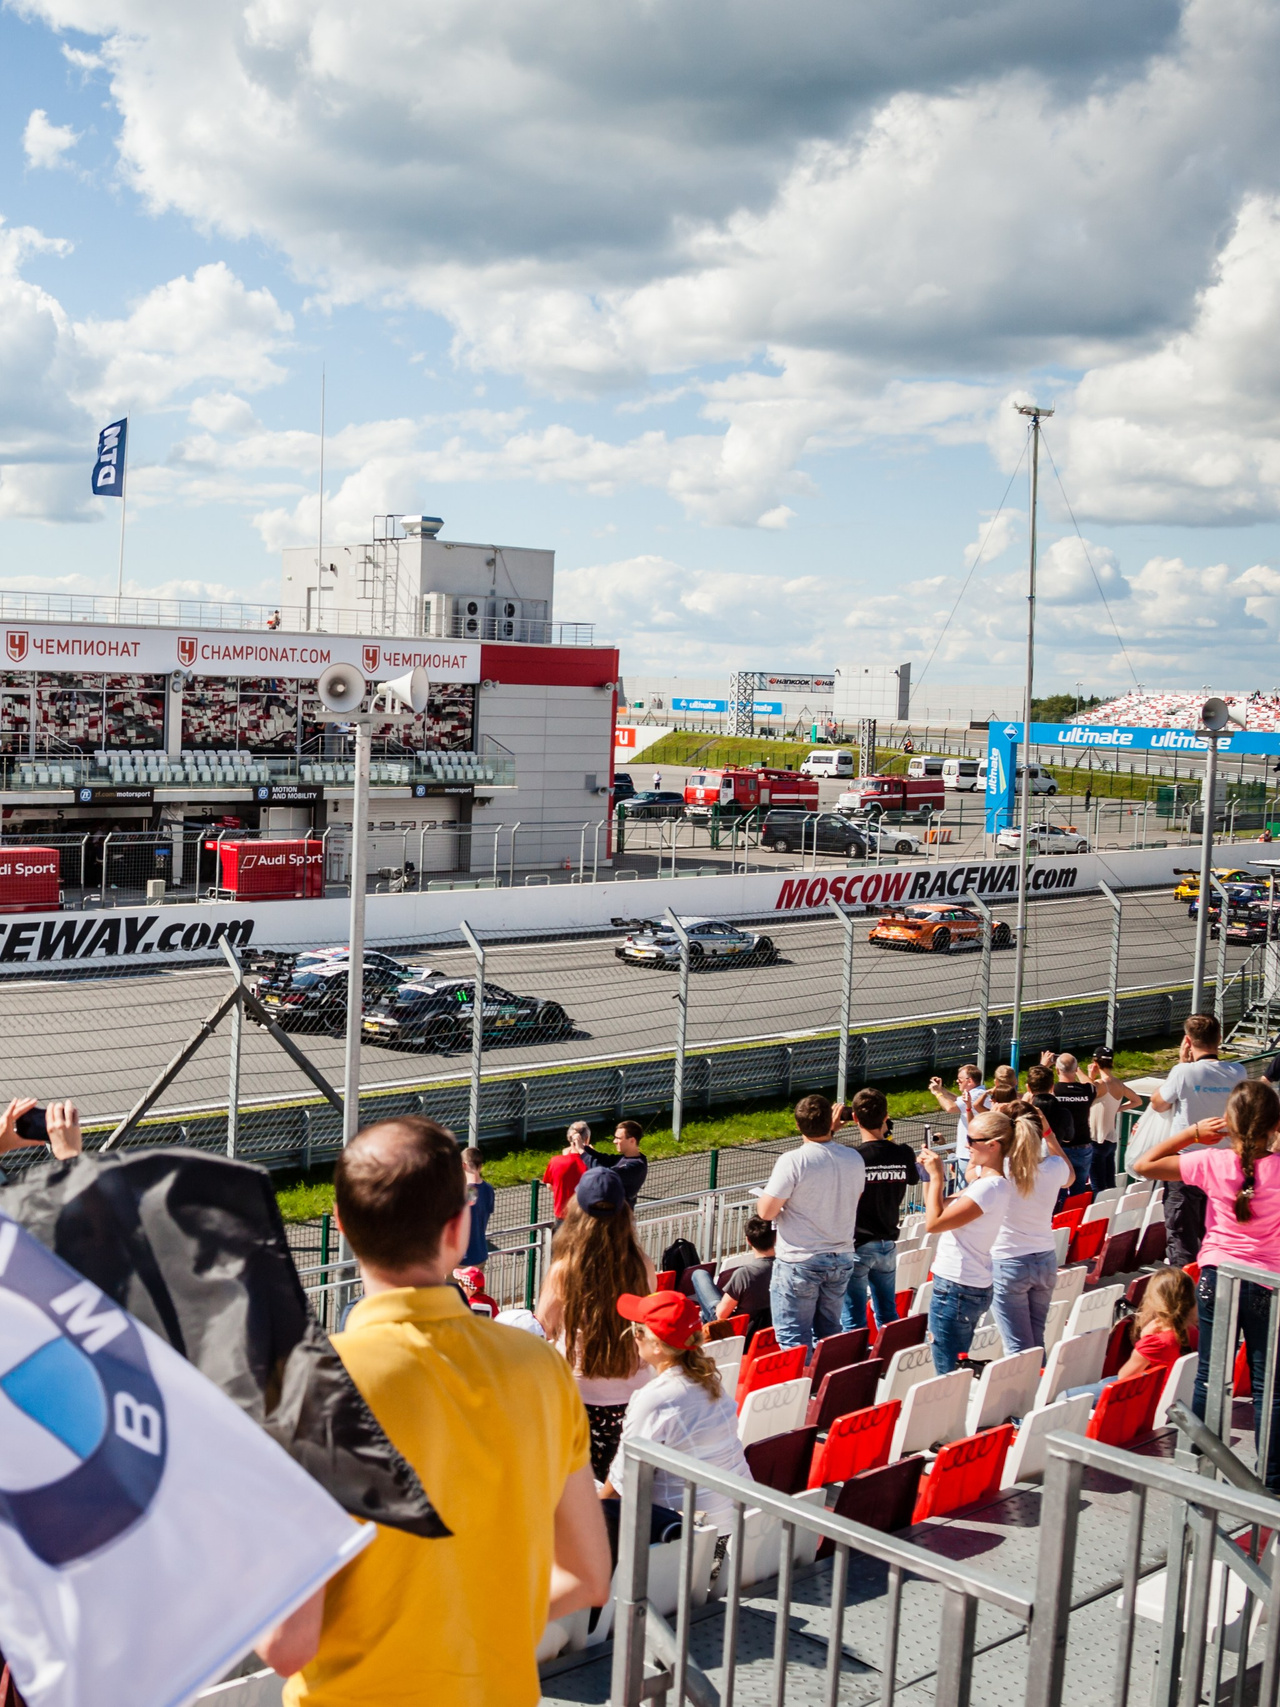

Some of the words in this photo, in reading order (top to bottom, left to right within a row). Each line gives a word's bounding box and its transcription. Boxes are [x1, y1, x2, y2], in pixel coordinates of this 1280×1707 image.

[32, 638, 141, 658] ЧЕМПИОНАТ
[201, 644, 331, 663] CHAMPIONAT.COM
[383, 652, 467, 669] ЧЕМПИОНАТ
[689, 700, 717, 710] ultimate
[1058, 727, 1134, 746] ultimate
[1150, 731, 1232, 750] ultimae
[989, 747, 1001, 795] ultimate
[258, 854, 286, 866] Audi
[15, 863, 56, 877] Sport
[775, 872, 912, 910] MOSCOW
